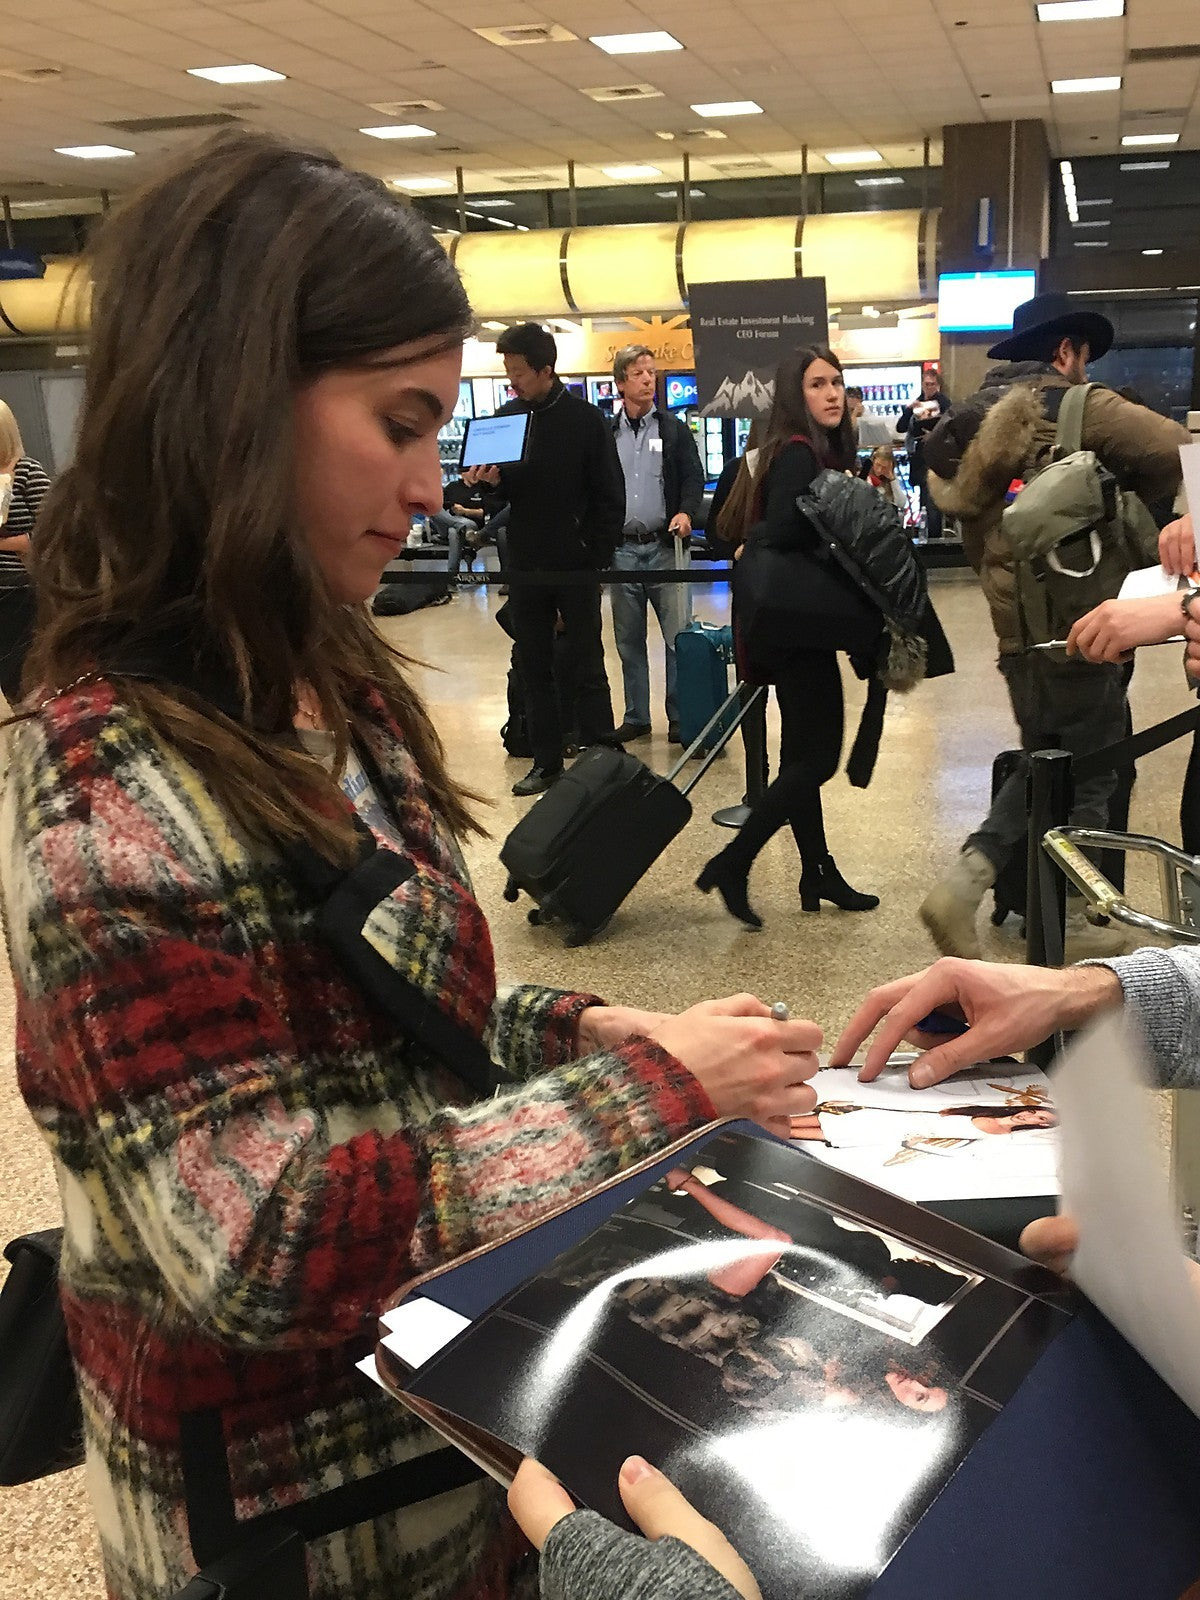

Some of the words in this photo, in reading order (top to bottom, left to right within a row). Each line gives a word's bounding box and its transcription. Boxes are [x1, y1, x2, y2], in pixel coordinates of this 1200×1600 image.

[700, 317, 716, 326] Real
[717, 317, 739, 326] Estate
[740, 316, 780, 325] Investment
[782, 314, 815, 326] Banking
[736, 330, 753, 339] CEO
[754, 330, 779, 338] Forum
